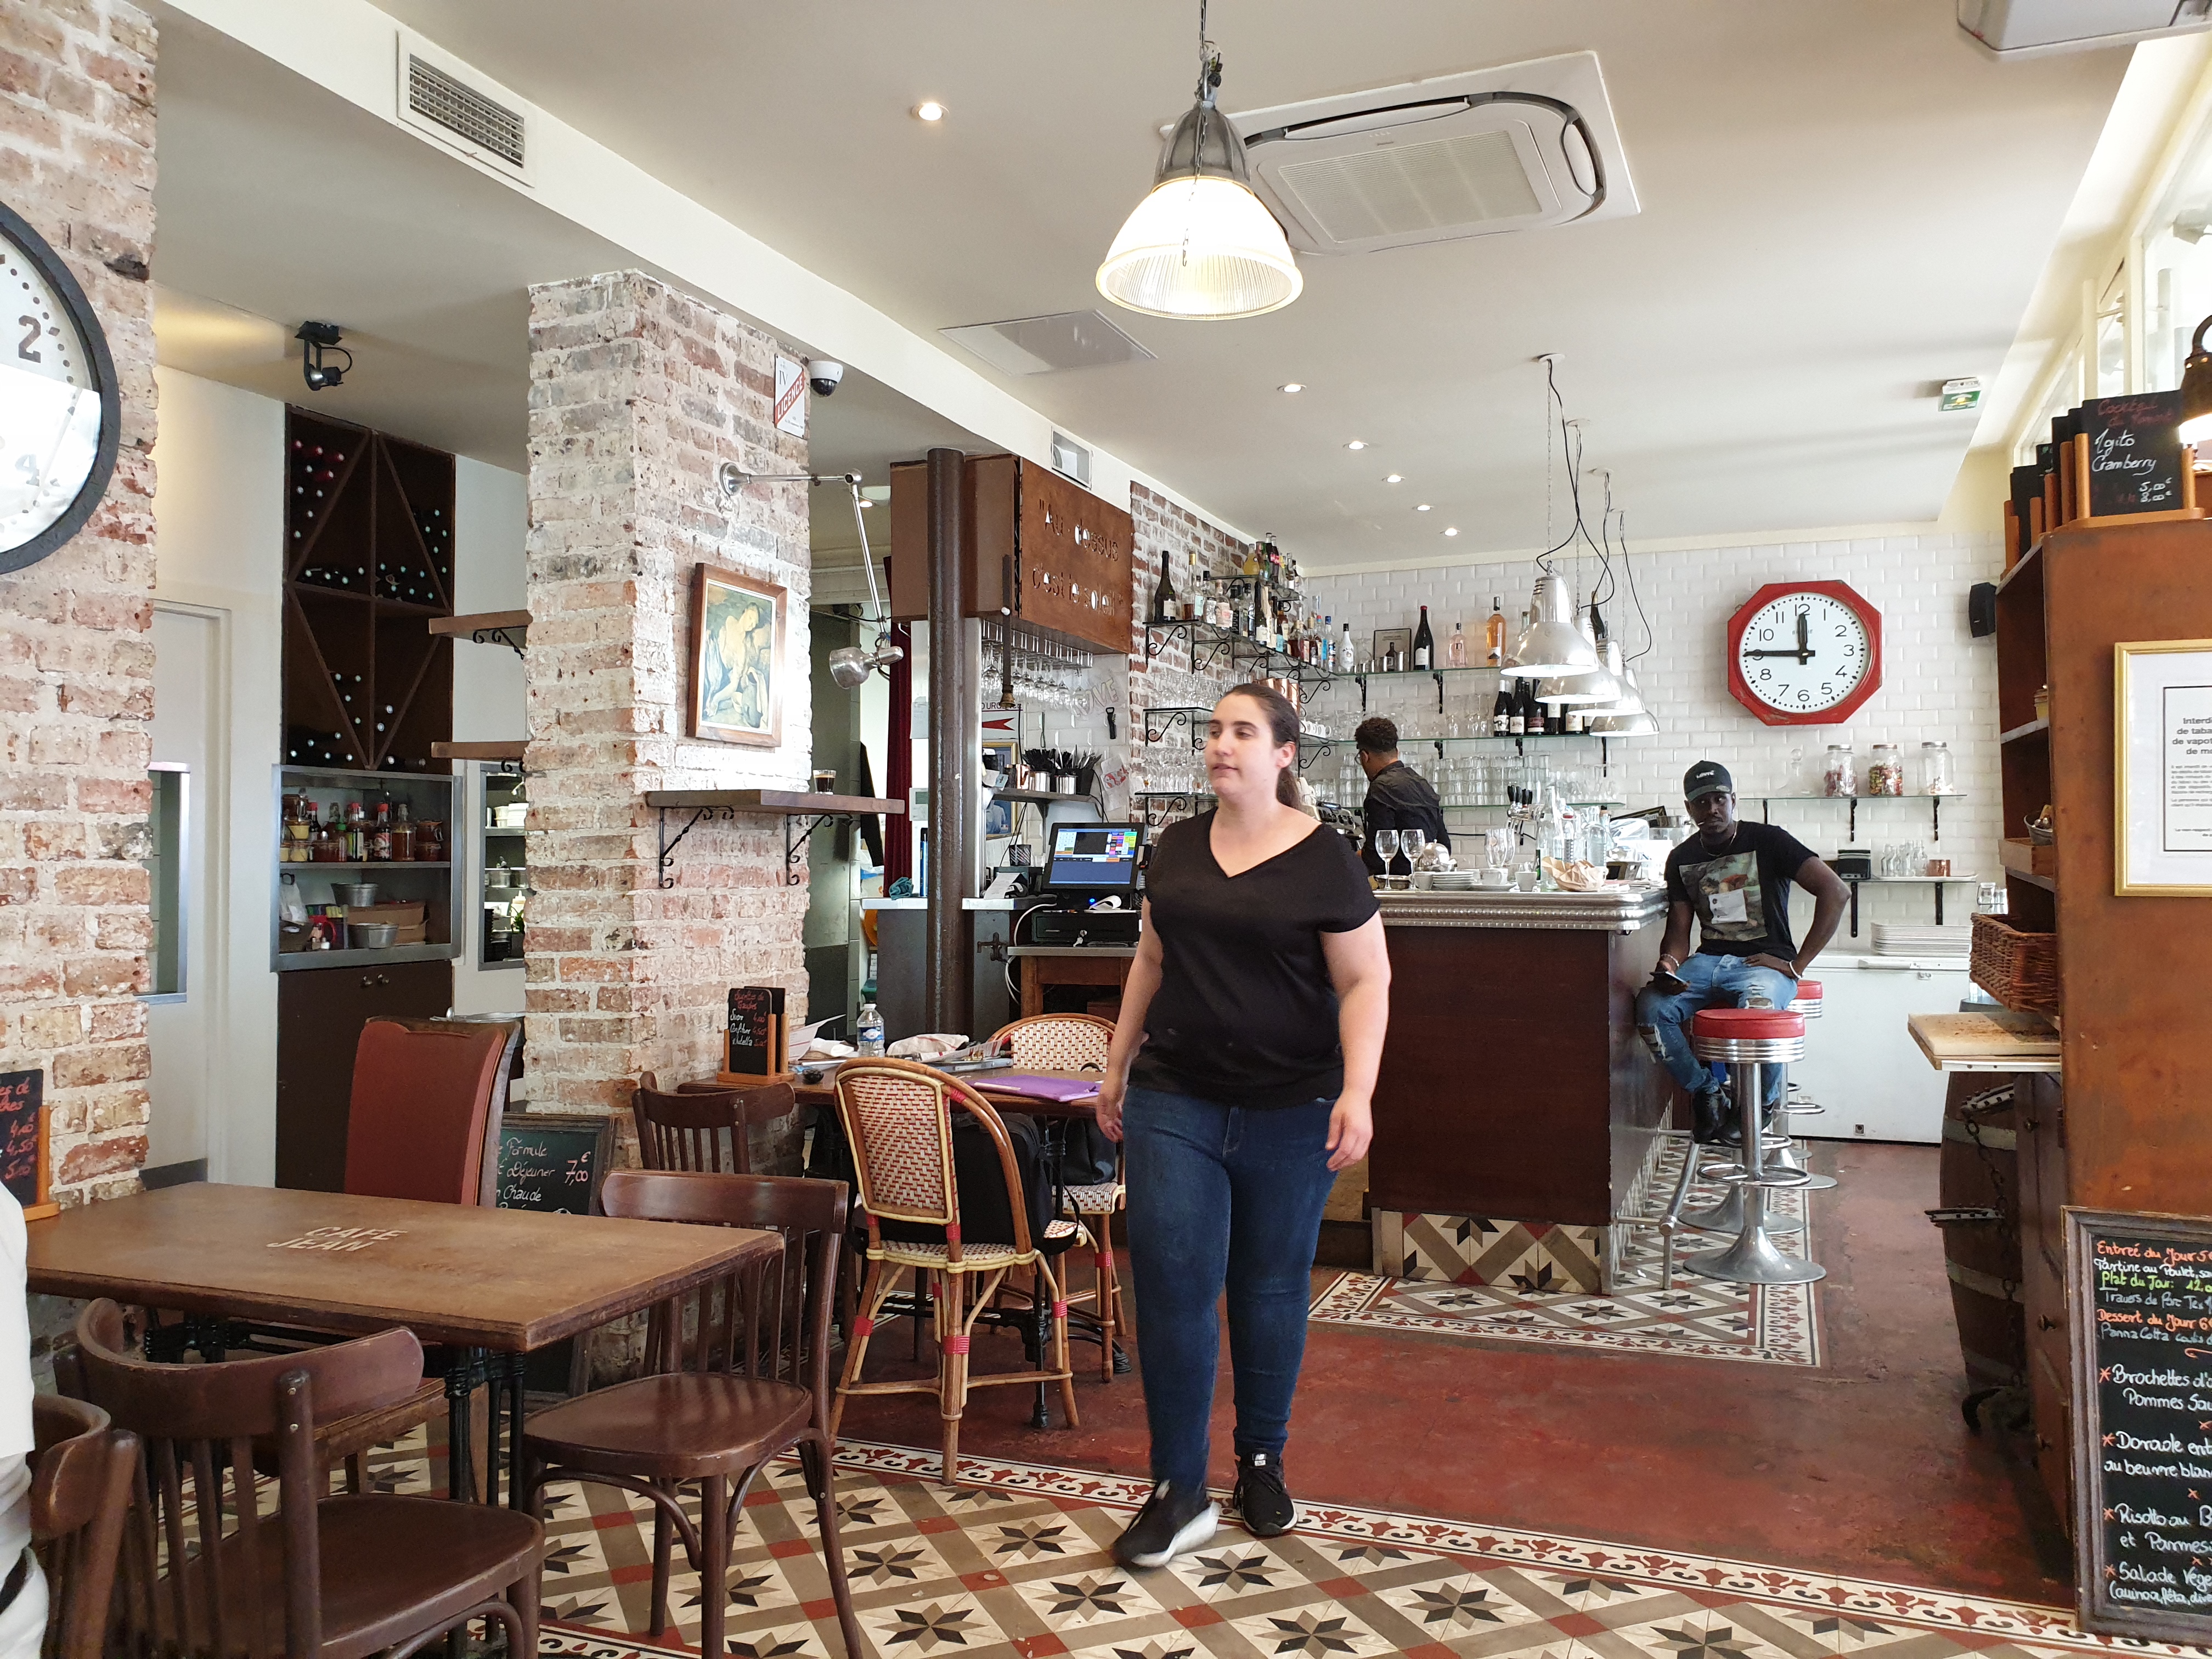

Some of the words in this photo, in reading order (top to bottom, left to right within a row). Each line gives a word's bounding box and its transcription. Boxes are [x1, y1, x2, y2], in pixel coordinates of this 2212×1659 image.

[19, 315, 41, 363] 2
[780, 370, 788, 385] IV
[777, 375, 803, 419] LICENCE
[2092, 454, 2157, 476] Cramberry
[1795, 604, 1810, 616] 12
[1759, 629, 1774, 641] 10
[1835, 625, 1847, 637] 2
[1843, 645, 1854, 656] 3
[1760, 668, 1772, 680] 8
[1835, 665, 1847, 678] 4
[1778, 684, 1790, 697] 7
[1797, 690, 1810, 702] 6
[1821, 682, 1832, 695] 5
[506, 1137, 548, 1157] Formule
[507, 1161, 556, 1185] Déjeuner
[504, 1183, 541, 1201] Chaude
[266, 1238, 376, 1251] JEAN
[2094, 1257, 2141, 1272] Tartine
[2142, 1265, 2158, 1273] au
[2144, 1247, 2162, 1259] du
[2163, 1248, 2197, 1267] Jour
[2102, 1271, 2127, 1288] Plat
[2130, 1273, 2146, 1287] du
[2145, 1292, 2158, 1306] de
[2097, 1308, 2143, 1323] Dessert
[2147, 1313, 2163, 1325] du
[2165, 1313, 2197, 1332] Jour
[2101, 1322, 2139, 1340] Panna
[2140, 1326, 2170, 1341] Cotta
[2112, 1364, 2190, 1387] Brochettes
[2123, 1387, 2184, 1410] Pommes
[2115, 1431, 2183, 1453] Dorade
[2104, 1460, 2123, 1472] au
[2124, 1459, 2178, 1477] beurre
[2179, 1462, 2212, 1478] blan
[2114, 1503, 2167, 1526] Risotto
[2169, 1516, 2191, 1527] au
[2120, 1531, 2137, 1548] et
[2119, 1561, 2177, 1584] Salade
